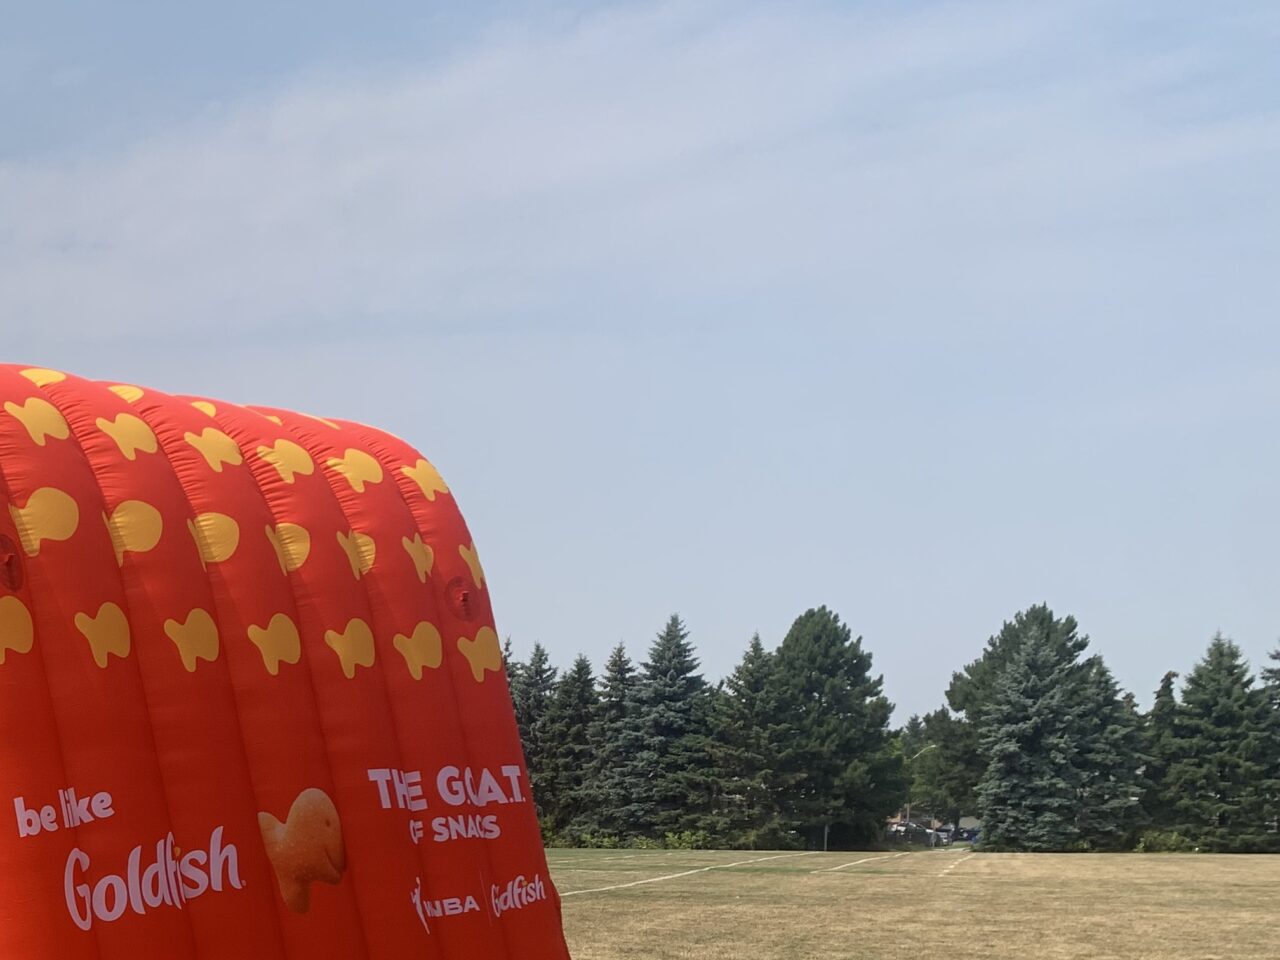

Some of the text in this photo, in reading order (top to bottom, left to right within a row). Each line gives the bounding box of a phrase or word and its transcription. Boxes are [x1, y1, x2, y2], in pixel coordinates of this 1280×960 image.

[13, 787, 116, 838] be like
[367, 768, 428, 812] THE
[431, 814, 501, 843] SNACS
[64, 825, 243, 931] Goldfish
[491, 873, 547, 918] Gdfish
